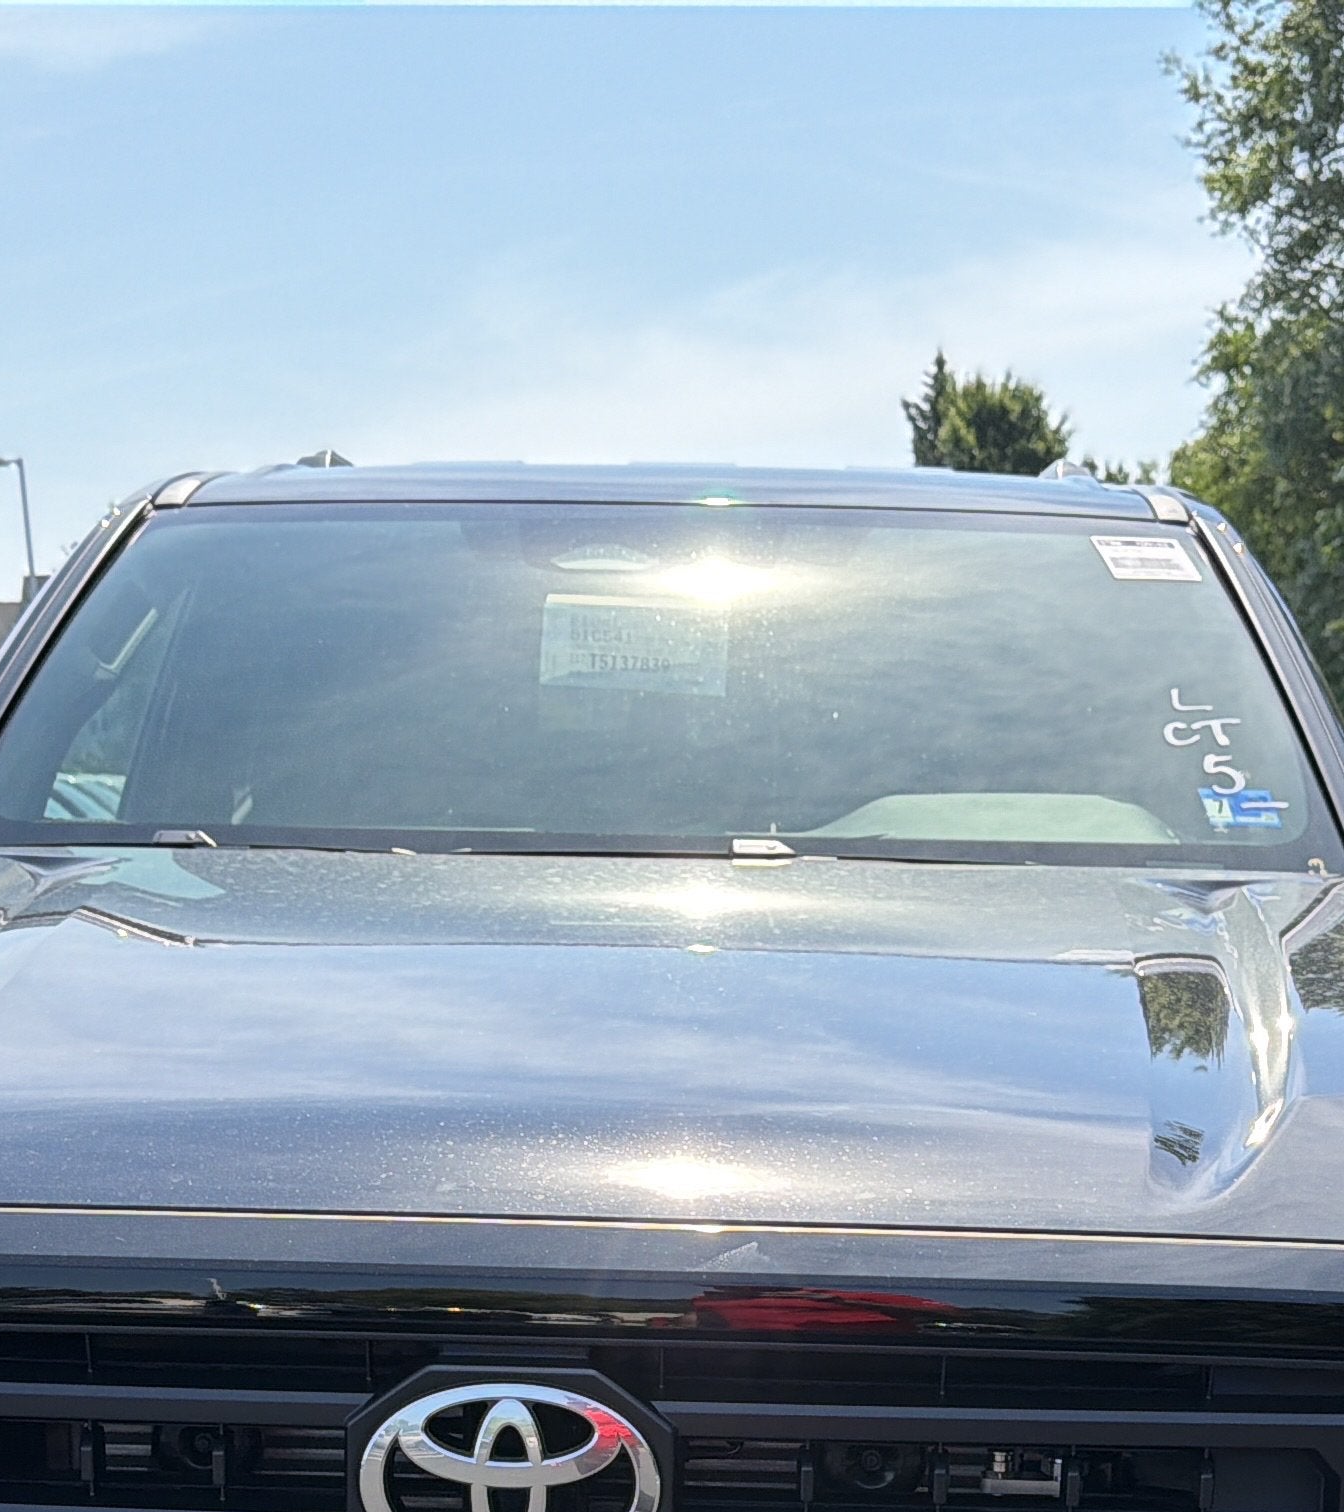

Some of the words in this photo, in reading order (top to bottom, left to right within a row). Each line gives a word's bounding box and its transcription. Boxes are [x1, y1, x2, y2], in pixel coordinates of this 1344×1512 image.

[1169, 686, 1214, 712] L
[1162, 717, 1242, 747] CT
[1202, 752, 1247, 796] 5
